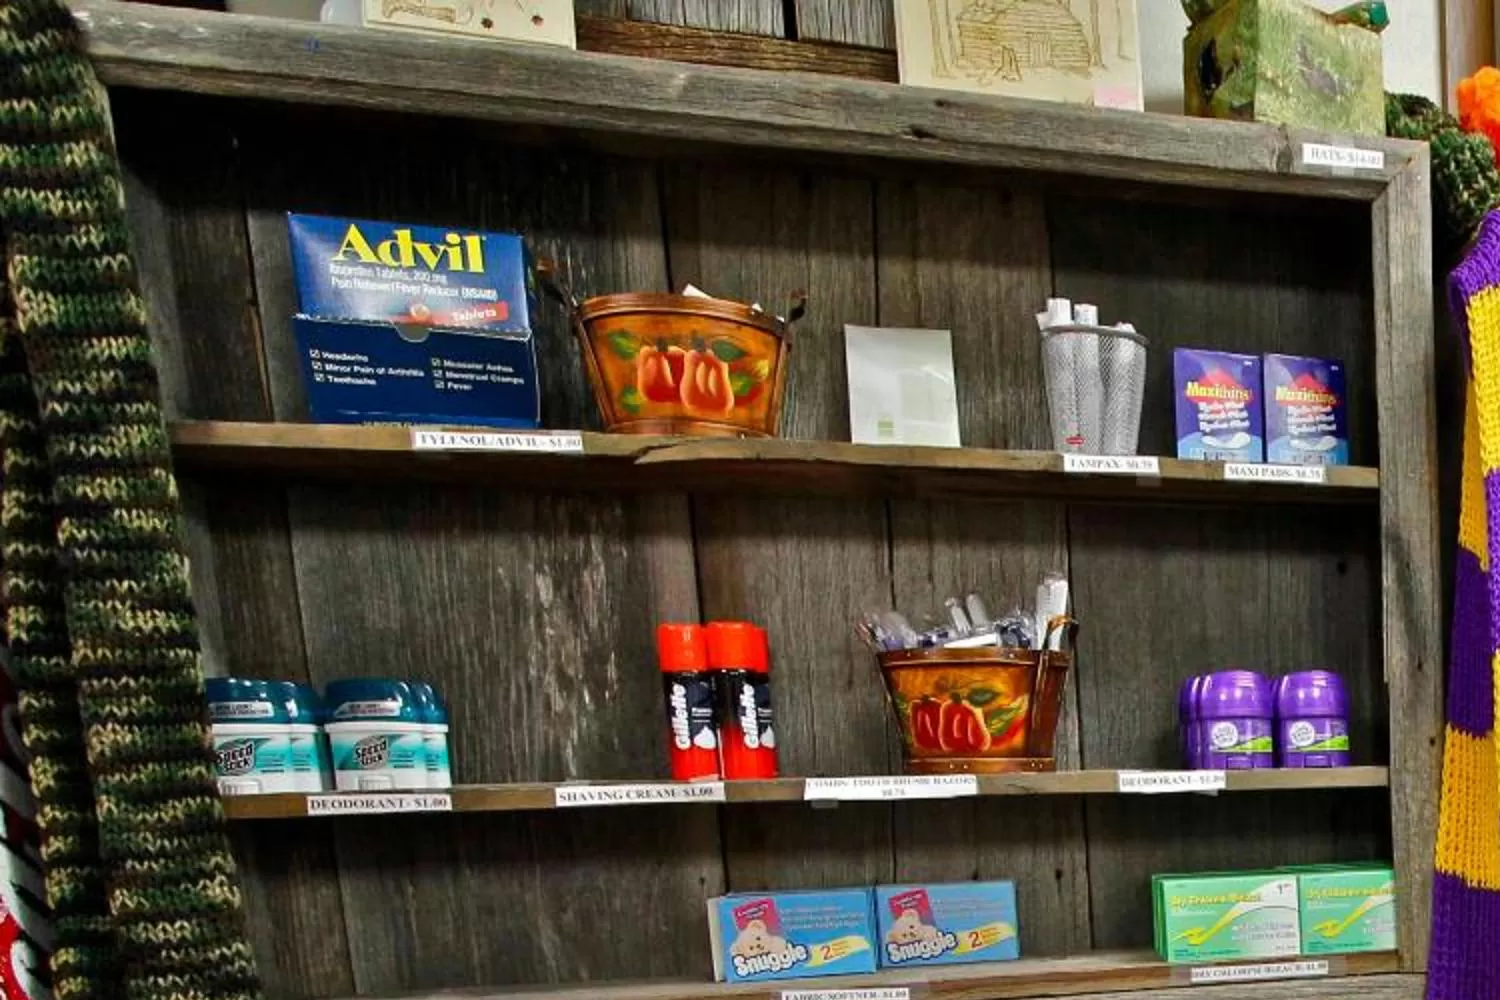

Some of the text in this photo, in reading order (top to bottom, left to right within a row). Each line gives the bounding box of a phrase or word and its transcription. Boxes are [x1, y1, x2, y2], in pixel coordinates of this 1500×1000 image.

[331, 223, 485, 273] Advil
[559, 790, 623, 802] SHAVING
[733, 942, 807, 977] Snuggle
[886, 931, 956, 963] Snuggle
